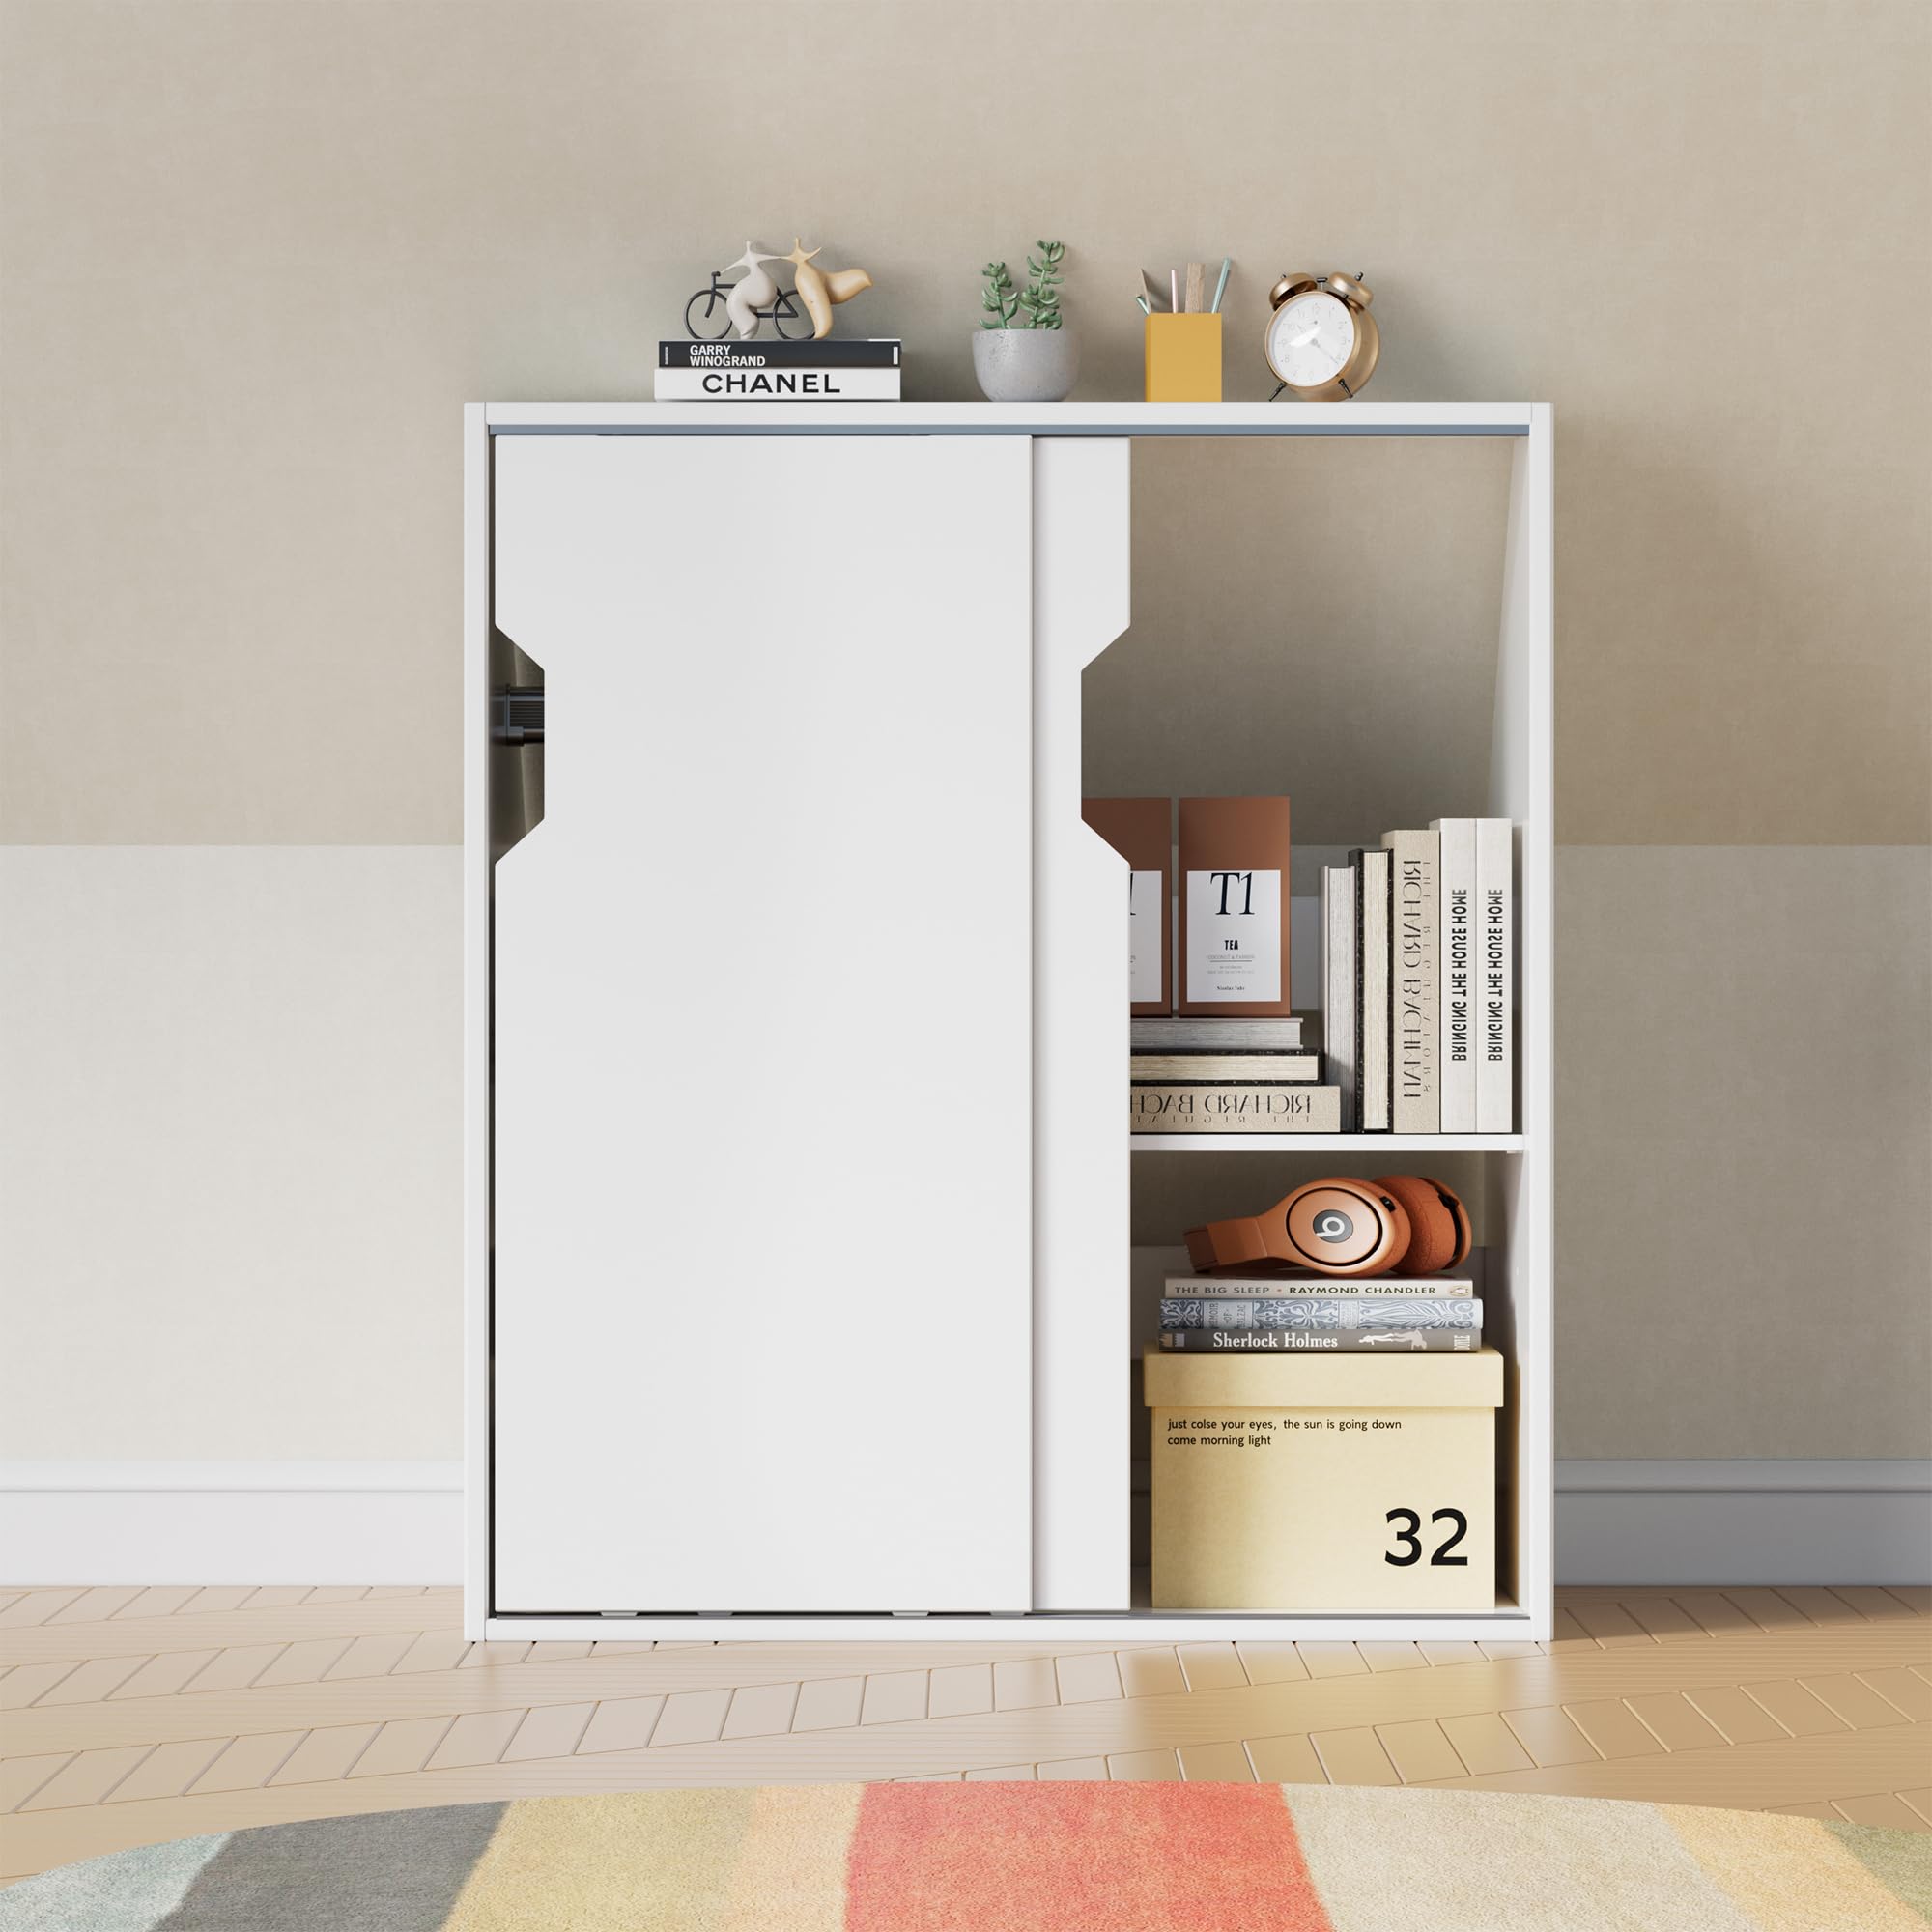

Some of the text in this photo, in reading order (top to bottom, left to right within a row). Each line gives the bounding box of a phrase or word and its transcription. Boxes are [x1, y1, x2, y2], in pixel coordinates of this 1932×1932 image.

[690, 344, 731, 355] GARRY
[690, 355, 766, 367] WINOGRAND
[702, 373, 840, 394] CHANEL
[1210, 871, 1255, 915] T1
[1224, 939, 1239, 951] TEA
[1175, 1286, 1436, 1294] THE BIG SLEEP RAYMOND CHANDLER
[1213, 1331, 1339, 1349] Sherlock Holmes
[1167, 1418, 1402, 1432] just colse your eyes, the sun is going down
[1167, 1435, 1271, 1448] come morning light
[1384, 1507, 1469, 1567] 32
